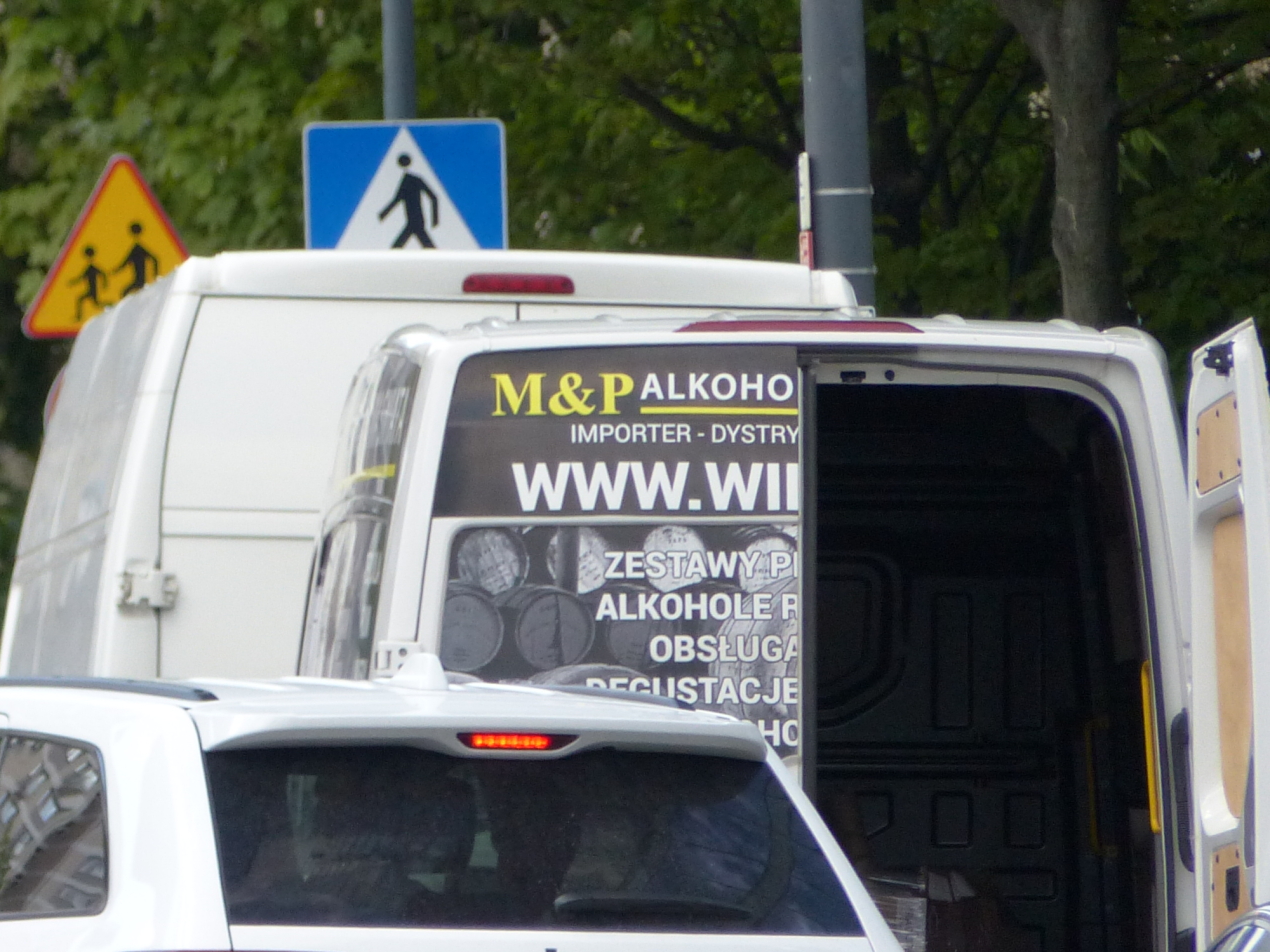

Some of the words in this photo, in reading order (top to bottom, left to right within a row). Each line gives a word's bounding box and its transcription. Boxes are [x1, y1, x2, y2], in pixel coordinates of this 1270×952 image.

[491, 372, 634, 416] M&P
[640, 373, 794, 401] ALKOHO
[571, 424, 691, 444] IMPORTER
[712, 424, 798, 444] DYSTRY
[604, 551, 761, 579] ZESTAWY
[771, 552, 799, 579] P
[595, 593, 773, 621] ALKOHOLE
